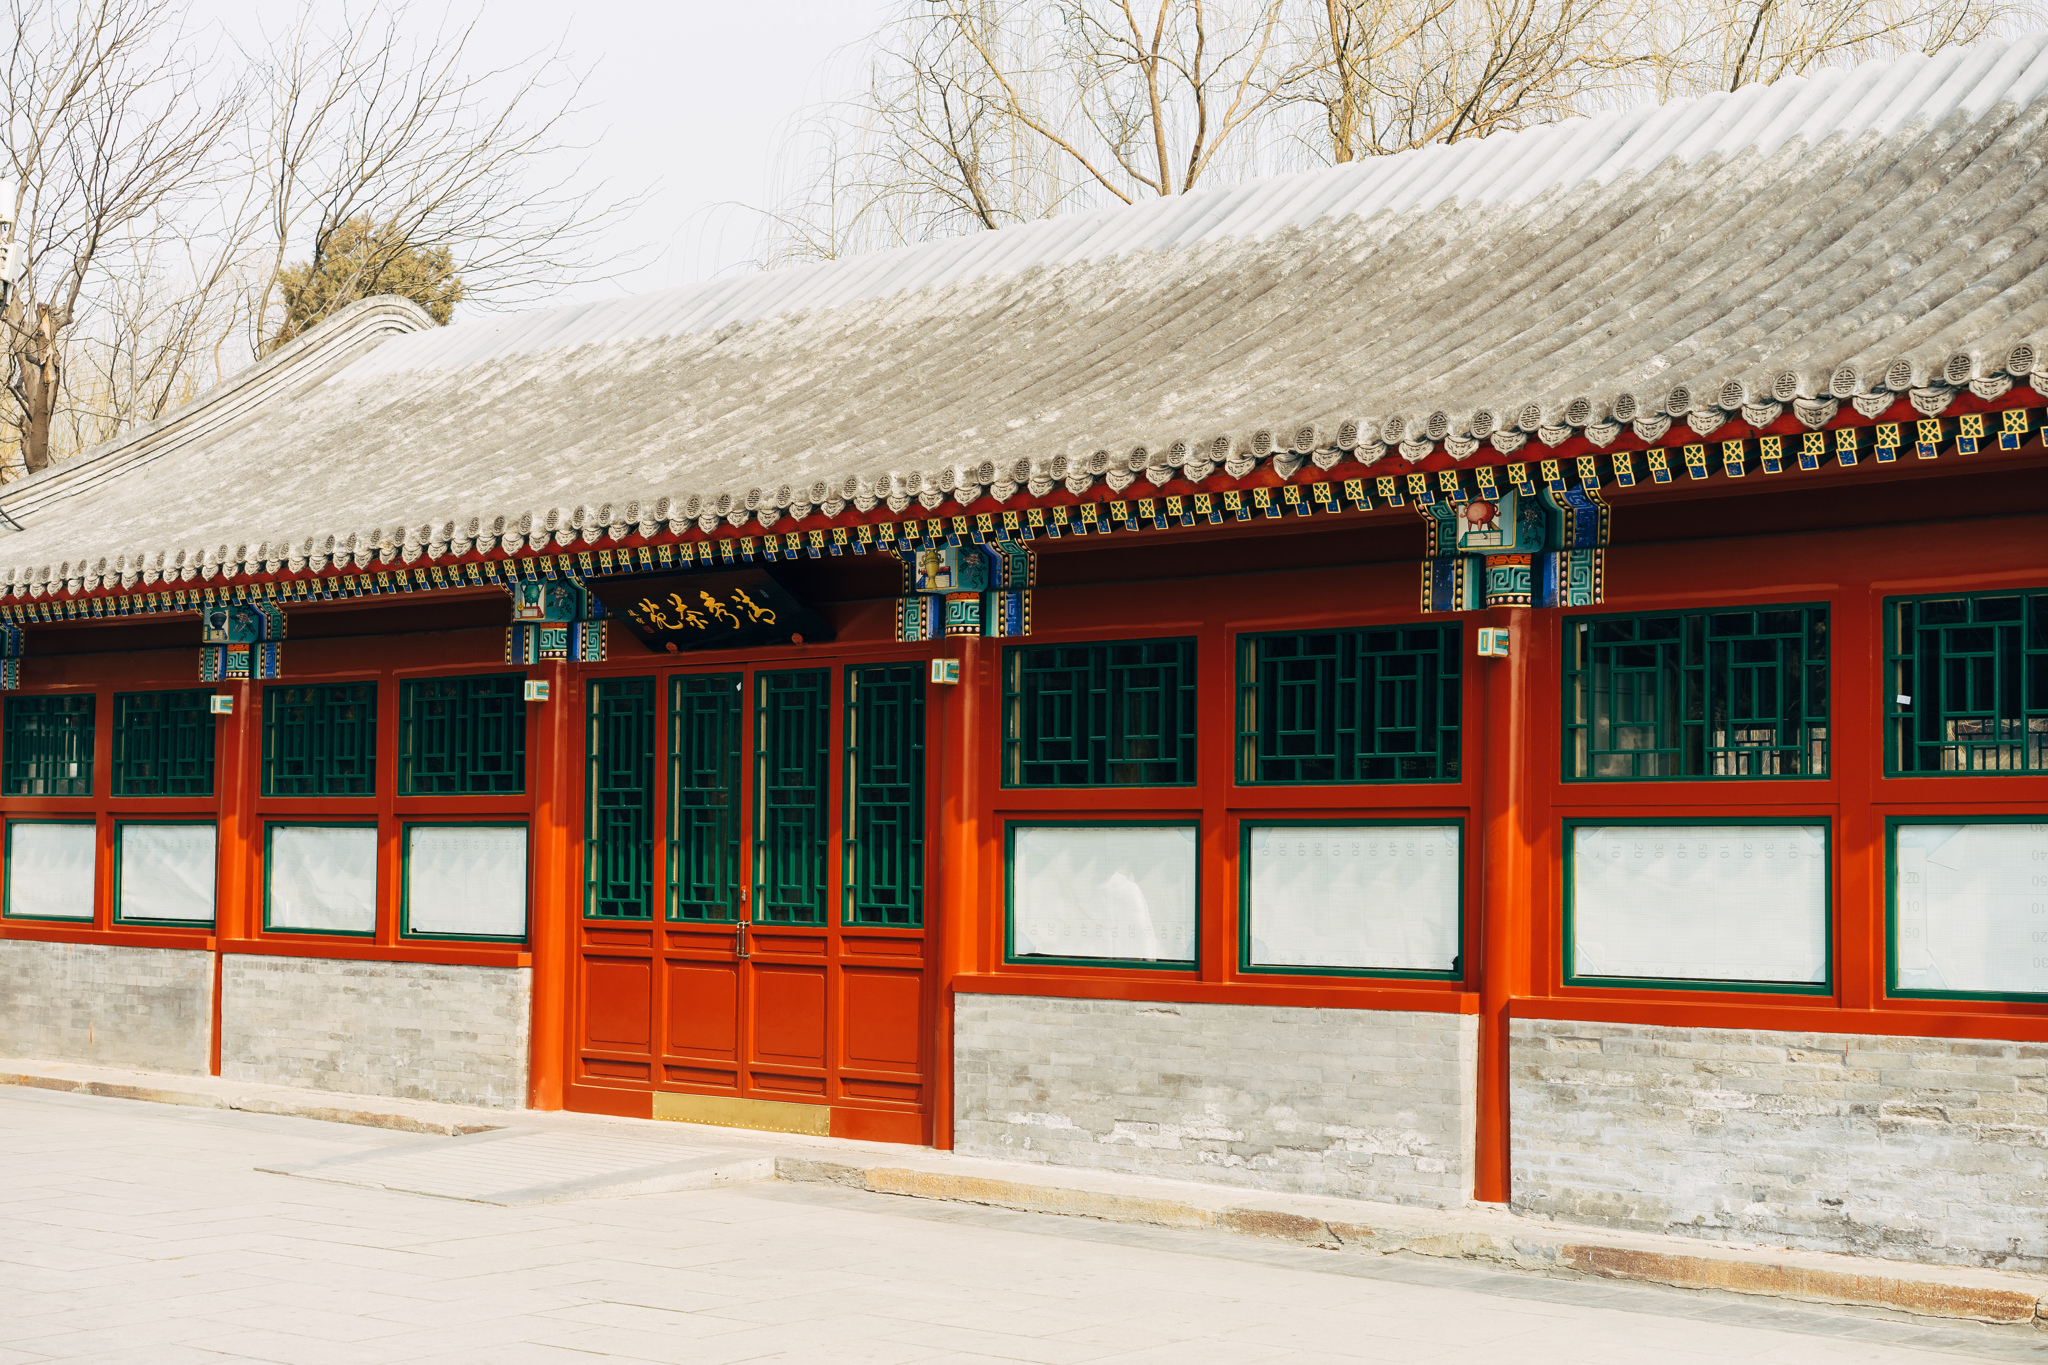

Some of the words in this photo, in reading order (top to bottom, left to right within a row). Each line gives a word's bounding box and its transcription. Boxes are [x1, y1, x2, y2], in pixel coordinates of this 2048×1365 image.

[1351, 842, 1360, 857] 20
[1369, 842, 1378, 857] 30
[1388, 842, 1398, 857] 40
[1425, 843, 1434, 857] 10
[1611, 844, 1621, 859] 10
[1633, 843, 1643, 859] 20
[1654, 843, 1664, 859] 30
[1677, 843, 1687, 859] 40
[1698, 843, 1708, 859] 50
[1719, 845, 1730, 859] 10
[1743, 842, 1753, 859] 20
[1764, 842, 1775, 860] 30
[1788, 842, 1799, 859] 40
[2032, 850, 2048, 861] 40
[2032, 875, 2048, 887] 50
[1906, 901, 1920, 913] 10
[2032, 902, 2047, 914] 10
[1905, 927, 1920, 939] 50
[2032, 931, 2048, 943] 20
[2033, 956, 2048, 969] 30
